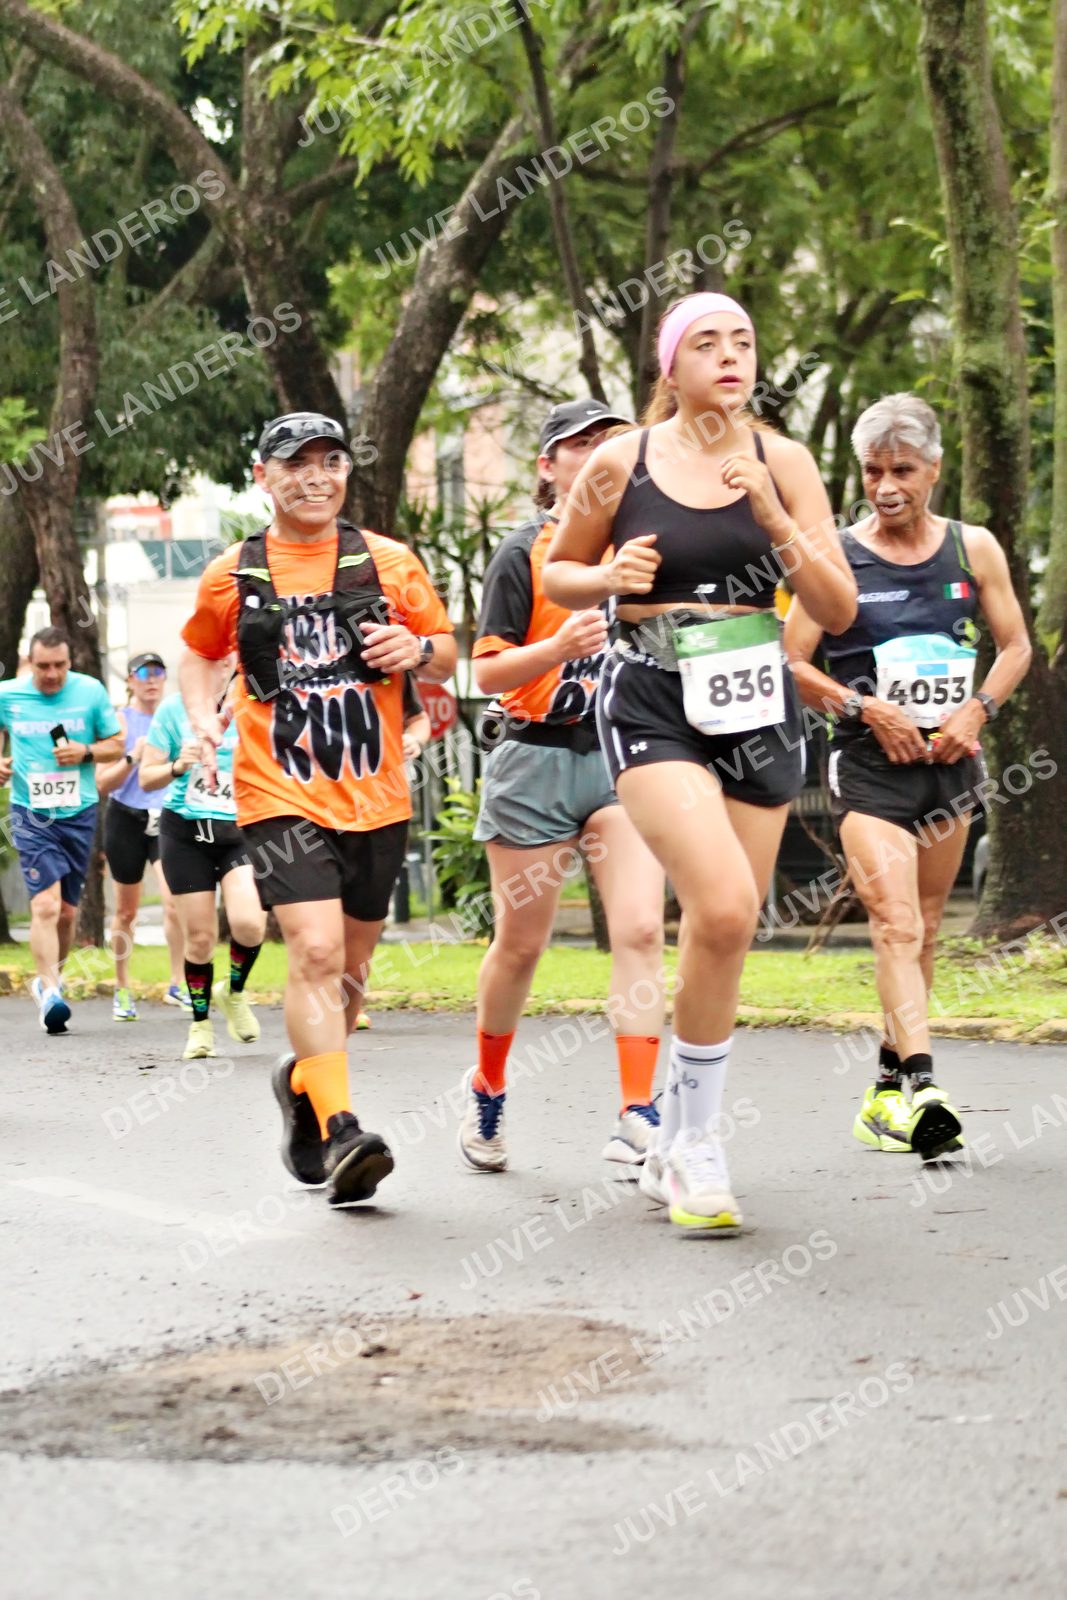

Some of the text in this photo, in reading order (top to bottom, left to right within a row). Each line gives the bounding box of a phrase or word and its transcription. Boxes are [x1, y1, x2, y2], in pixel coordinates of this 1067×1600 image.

[709, 665, 774, 707] 836
[887, 677, 966, 706] 4053
[32, 781, 76, 796] 3057
